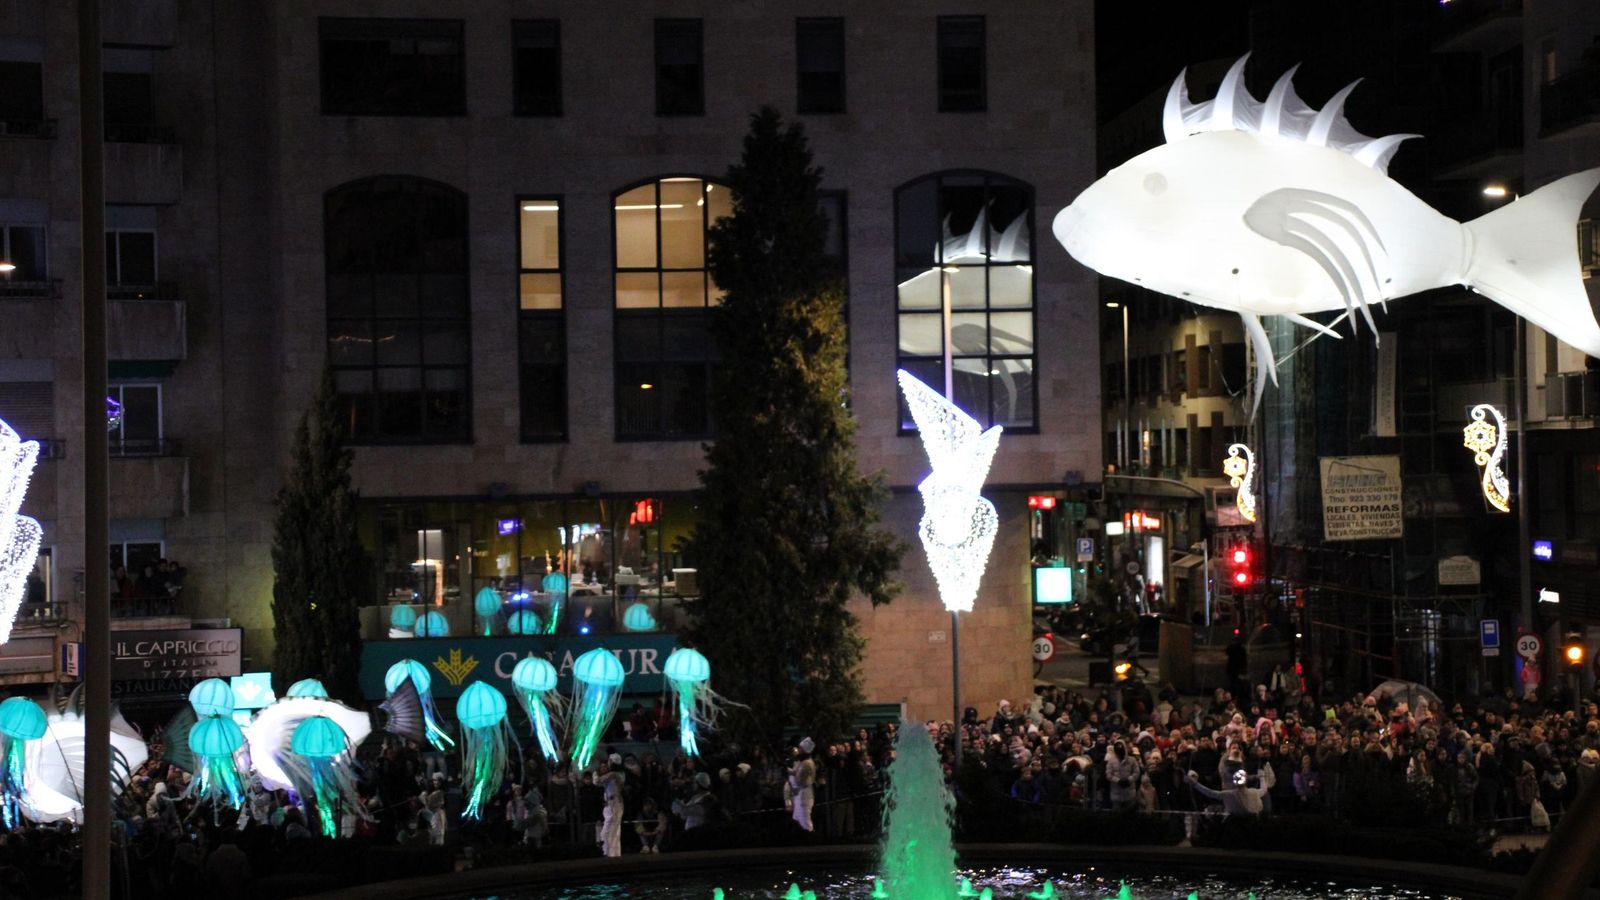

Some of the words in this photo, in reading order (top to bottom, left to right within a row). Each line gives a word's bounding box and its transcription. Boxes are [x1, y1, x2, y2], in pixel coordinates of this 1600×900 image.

[1326, 504, 1399, 513] REFORMAS
[1080, 540, 1090, 552] P
[117, 642, 130, 656] IL
[135, 640, 239, 655] CAPRICCIO
[1034, 643, 1050, 654] 30
[1520, 641, 1537, 651] 30
